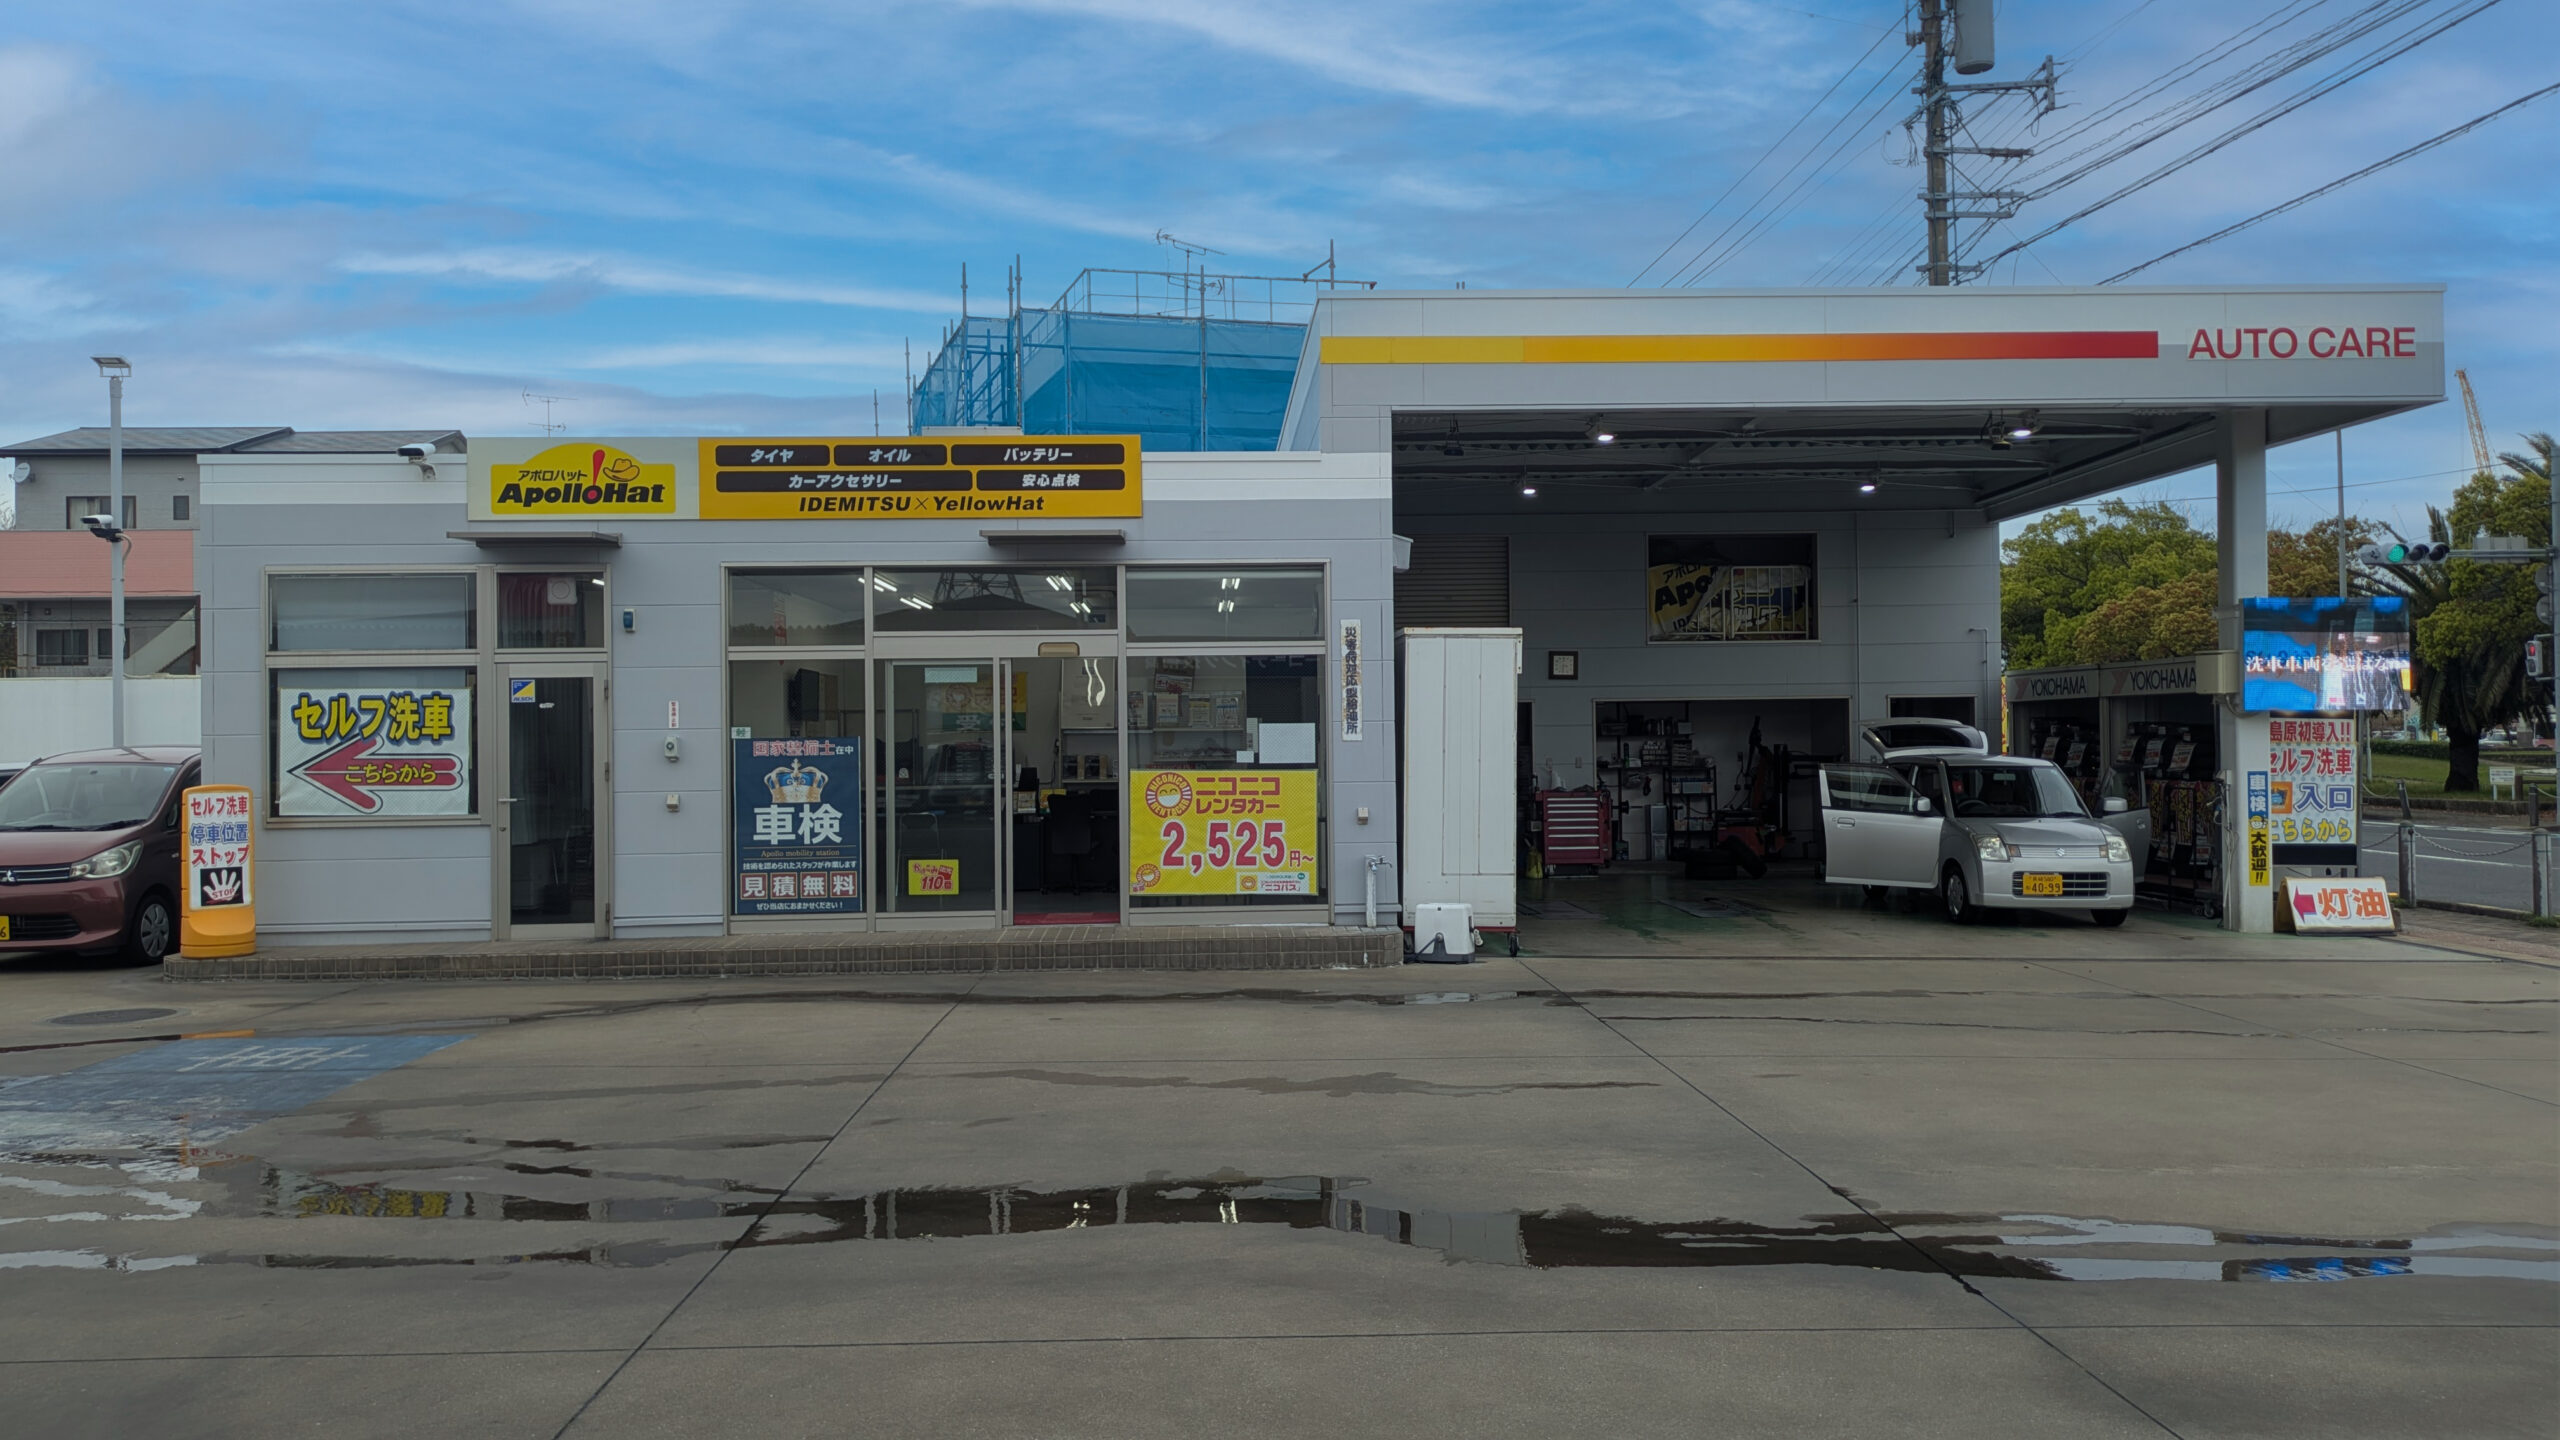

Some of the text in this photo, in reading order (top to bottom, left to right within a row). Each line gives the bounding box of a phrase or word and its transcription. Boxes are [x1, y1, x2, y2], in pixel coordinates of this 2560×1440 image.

[2188, 326, 2416, 359] AUTO CARE
[750, 448, 794, 463] タイヤ
[868, 448, 912, 462] オイル
[1003, 447, 1073, 462] バッテリー
[517, 469, 588, 482] アポロハット
[788, 474, 903, 489] カーアクセサリー
[1021, 473, 1081, 488] 安心点検
[2030, 676, 2087, 697] YOKOHAMA
[2129, 667, 2196, 691] YOKOHAMA
[292, 693, 454, 742] セルフ洗車
[345, 763, 437, 784] こちらから
[1196, 777, 1280, 796] ニコニコ
[191, 795, 248, 816] セルフ洗車
[1196, 798, 1280, 815] レンタカー
[2295, 783, 2354, 812] 入口
[191, 823, 249, 844] 停車位置
[752, 803, 843, 845] 車検
[192, 846, 249, 866] ストップ
[785, 849, 814, 857] mobility
[211, 888, 235, 899] STOP
[743, 874, 855, 898] 見積無料
[2317, 887, 2388, 918] 灯油
